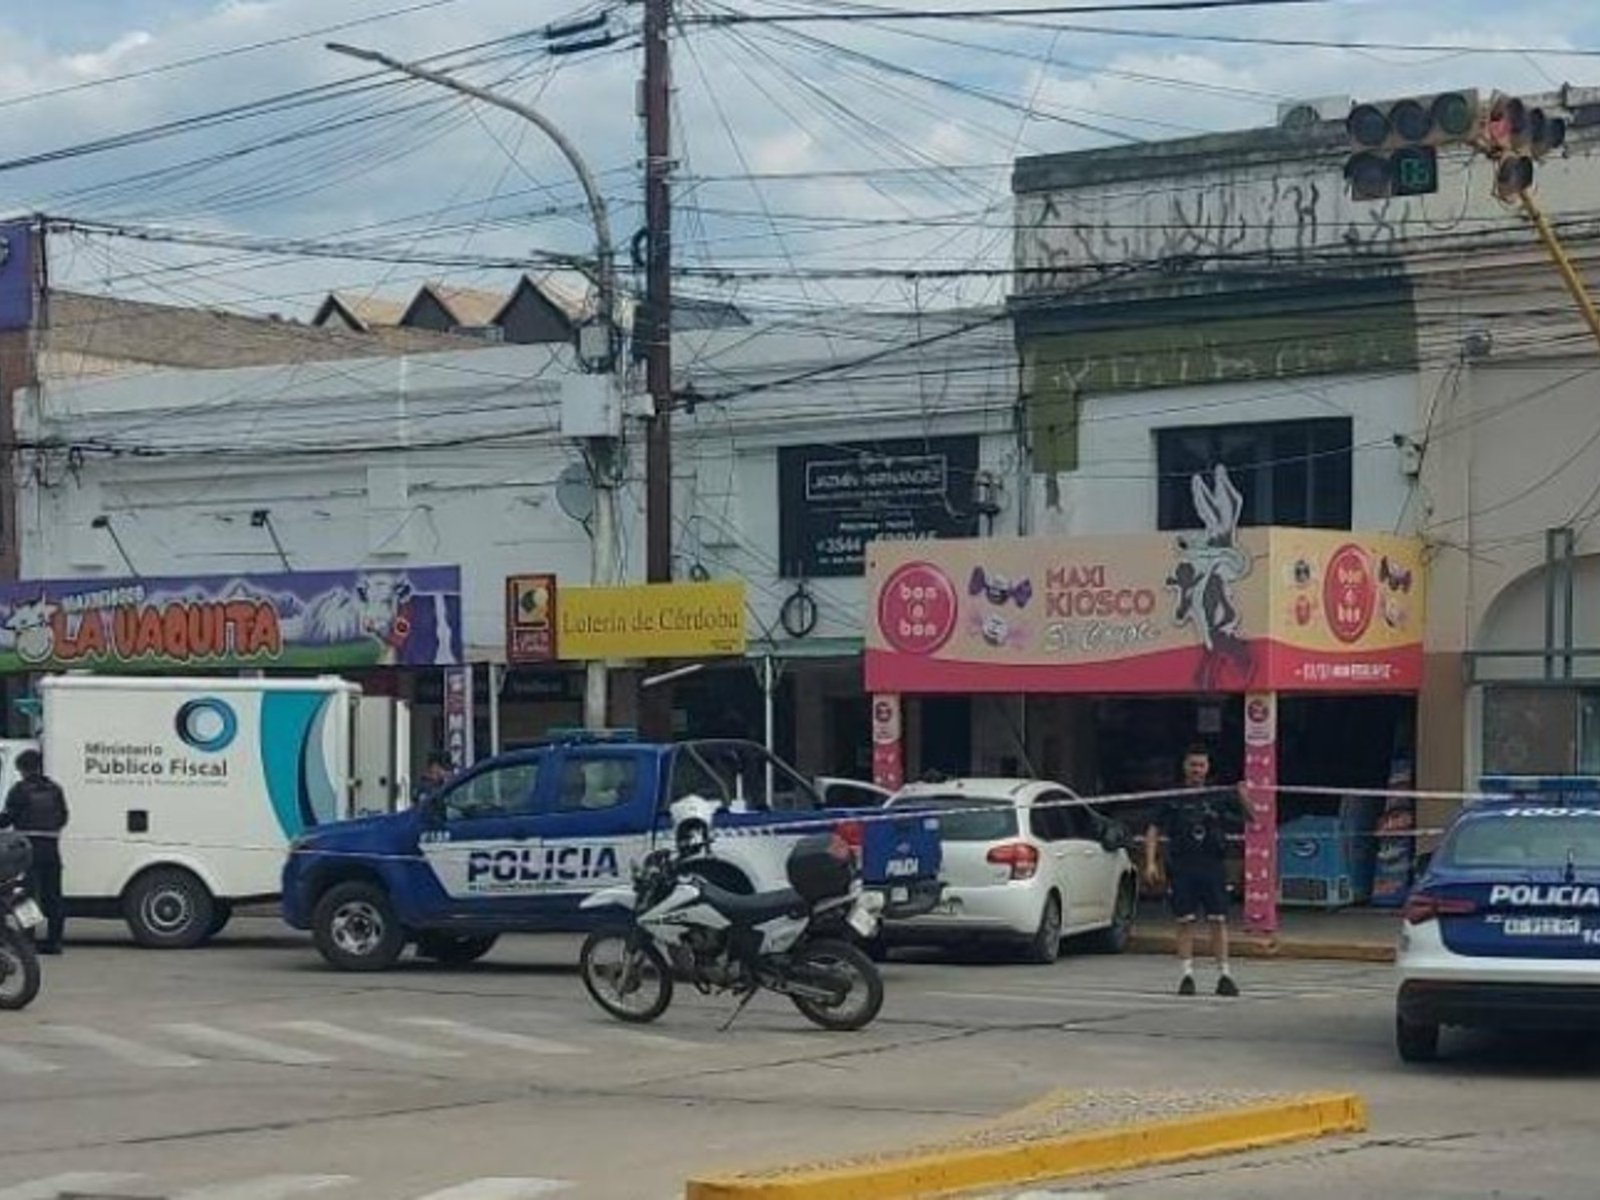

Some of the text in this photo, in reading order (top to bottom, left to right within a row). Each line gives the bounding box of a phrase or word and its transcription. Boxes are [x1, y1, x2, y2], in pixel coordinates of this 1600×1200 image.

[1046, 565, 1105, 589] MAXI
[900, 584, 937, 599] bon
[1046, 588, 1156, 618] KIOSCO
[633, 608, 653, 631] de
[900, 622, 937, 637] bon
[52, 608, 107, 661] LA
[84, 742, 164, 756] Ministerio
[169, 757, 228, 777] Fiscal
[468, 847, 619, 883] POLICIA
[1490, 884, 1600, 907] POLICIA
